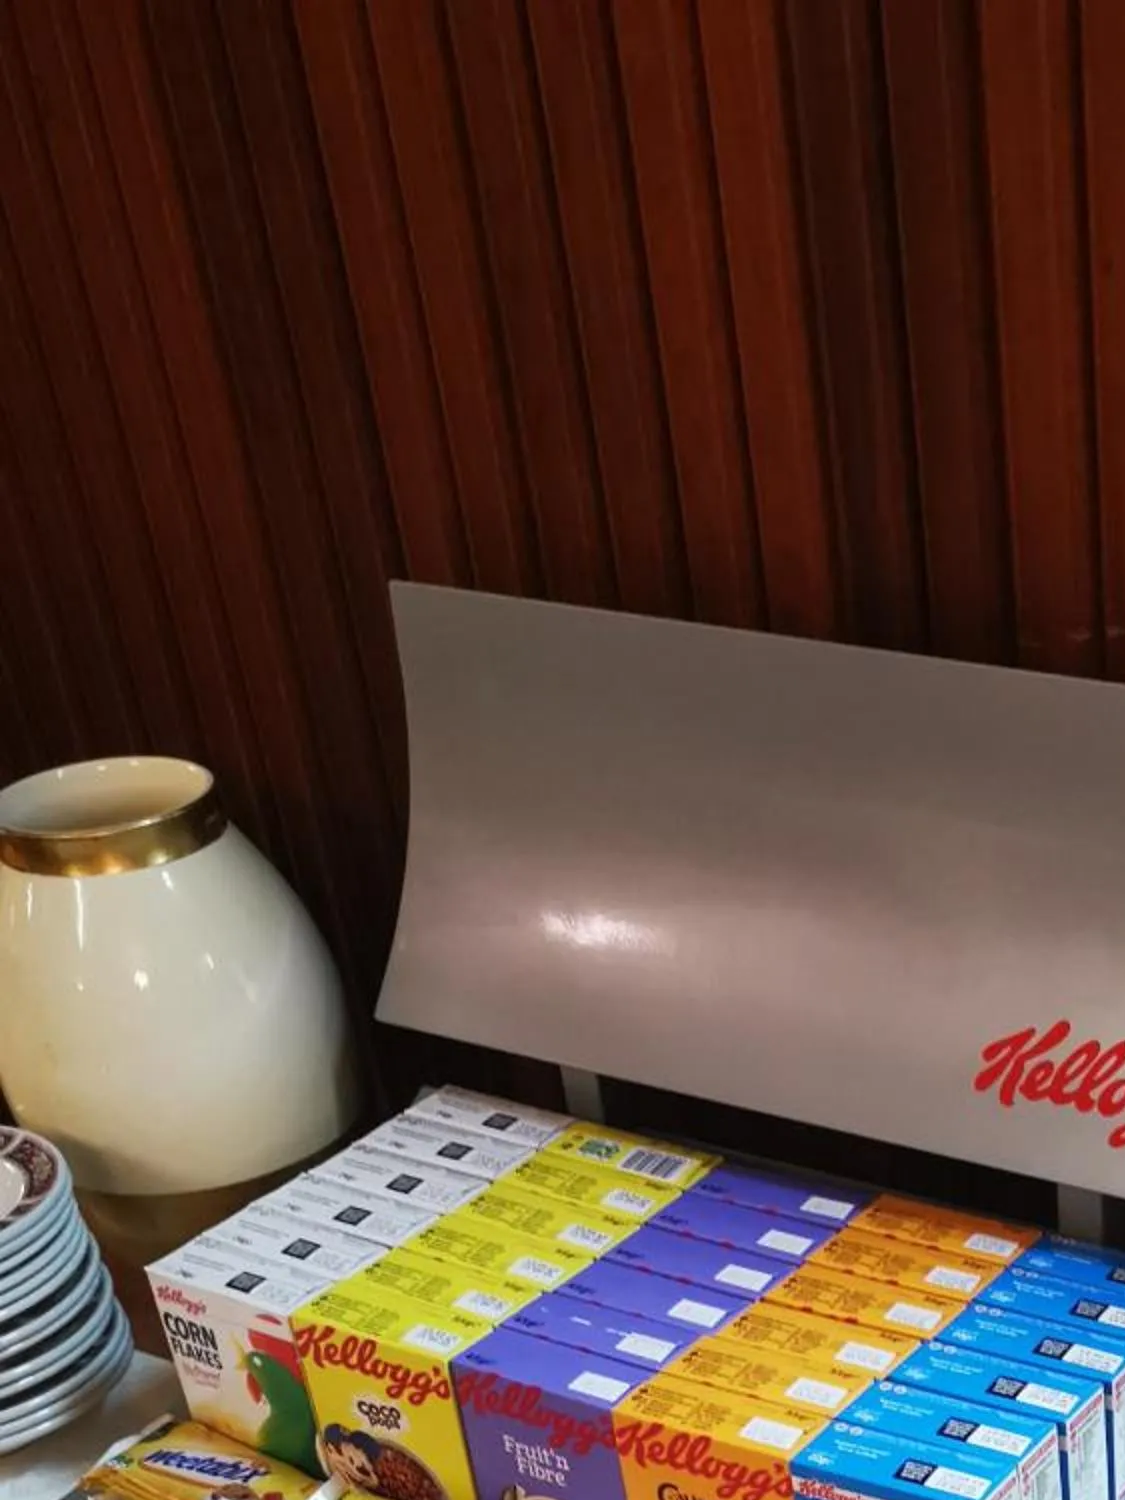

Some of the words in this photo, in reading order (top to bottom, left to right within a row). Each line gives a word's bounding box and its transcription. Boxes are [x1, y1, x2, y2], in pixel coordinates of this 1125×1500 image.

[156, 1284, 207, 1316] Kellogg's
[163, 1311, 218, 1351] CORN
[170, 1336, 223, 1370] FLAKES
[295, 1324, 450, 1405] Kellogg's
[458, 1370, 617, 1456] Kellogg's
[143, 1448, 272, 1482] Weetabix
[515, 1456, 568, 1487] Fibre
